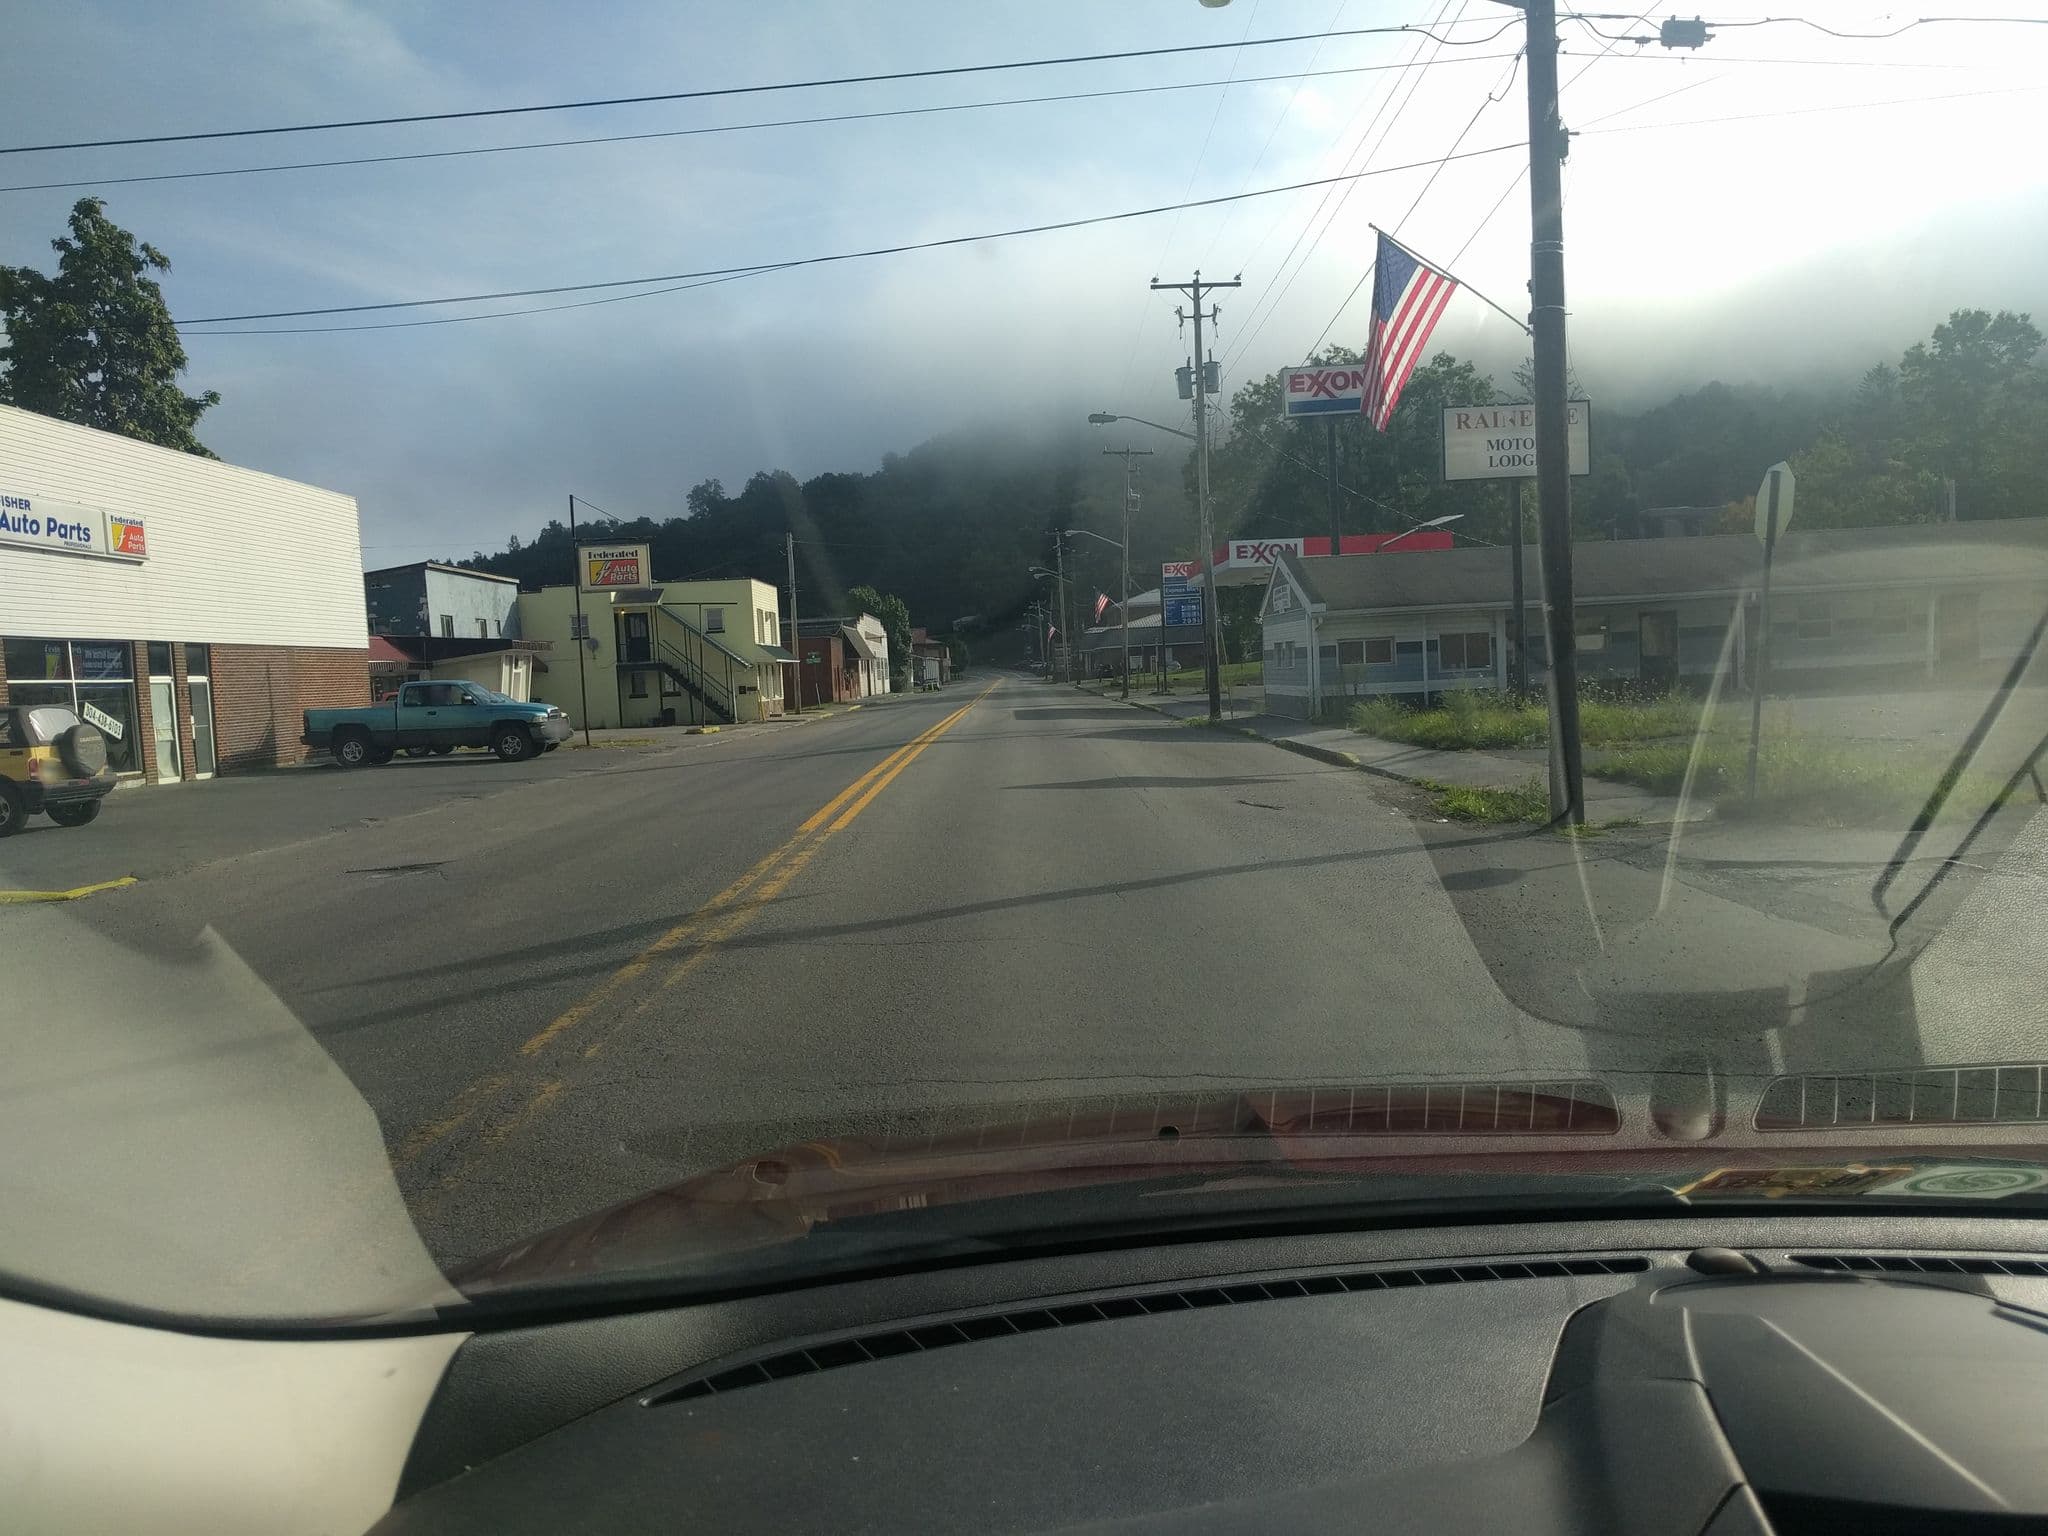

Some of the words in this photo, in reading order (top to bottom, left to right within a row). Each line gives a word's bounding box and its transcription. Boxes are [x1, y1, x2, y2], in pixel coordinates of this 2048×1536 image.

[1289, 370, 1365, 398] EXXON
[1456, 408, 1579, 430] RAINEE
[1486, 438, 1535, 452] MOTO
[1489, 454, 1536, 467] LODG
[0, 495, 31, 511] ISHER
[0, 509, 41, 536] Auto
[46, 517, 91, 543] Parts
[110, 515, 144, 527] Federated
[129, 533, 144, 542] Auto
[128, 542, 145, 552] Parts
[588, 550, 639, 559] Federated
[613, 565, 638, 573] Auto
[611, 572, 638, 582] Parts
